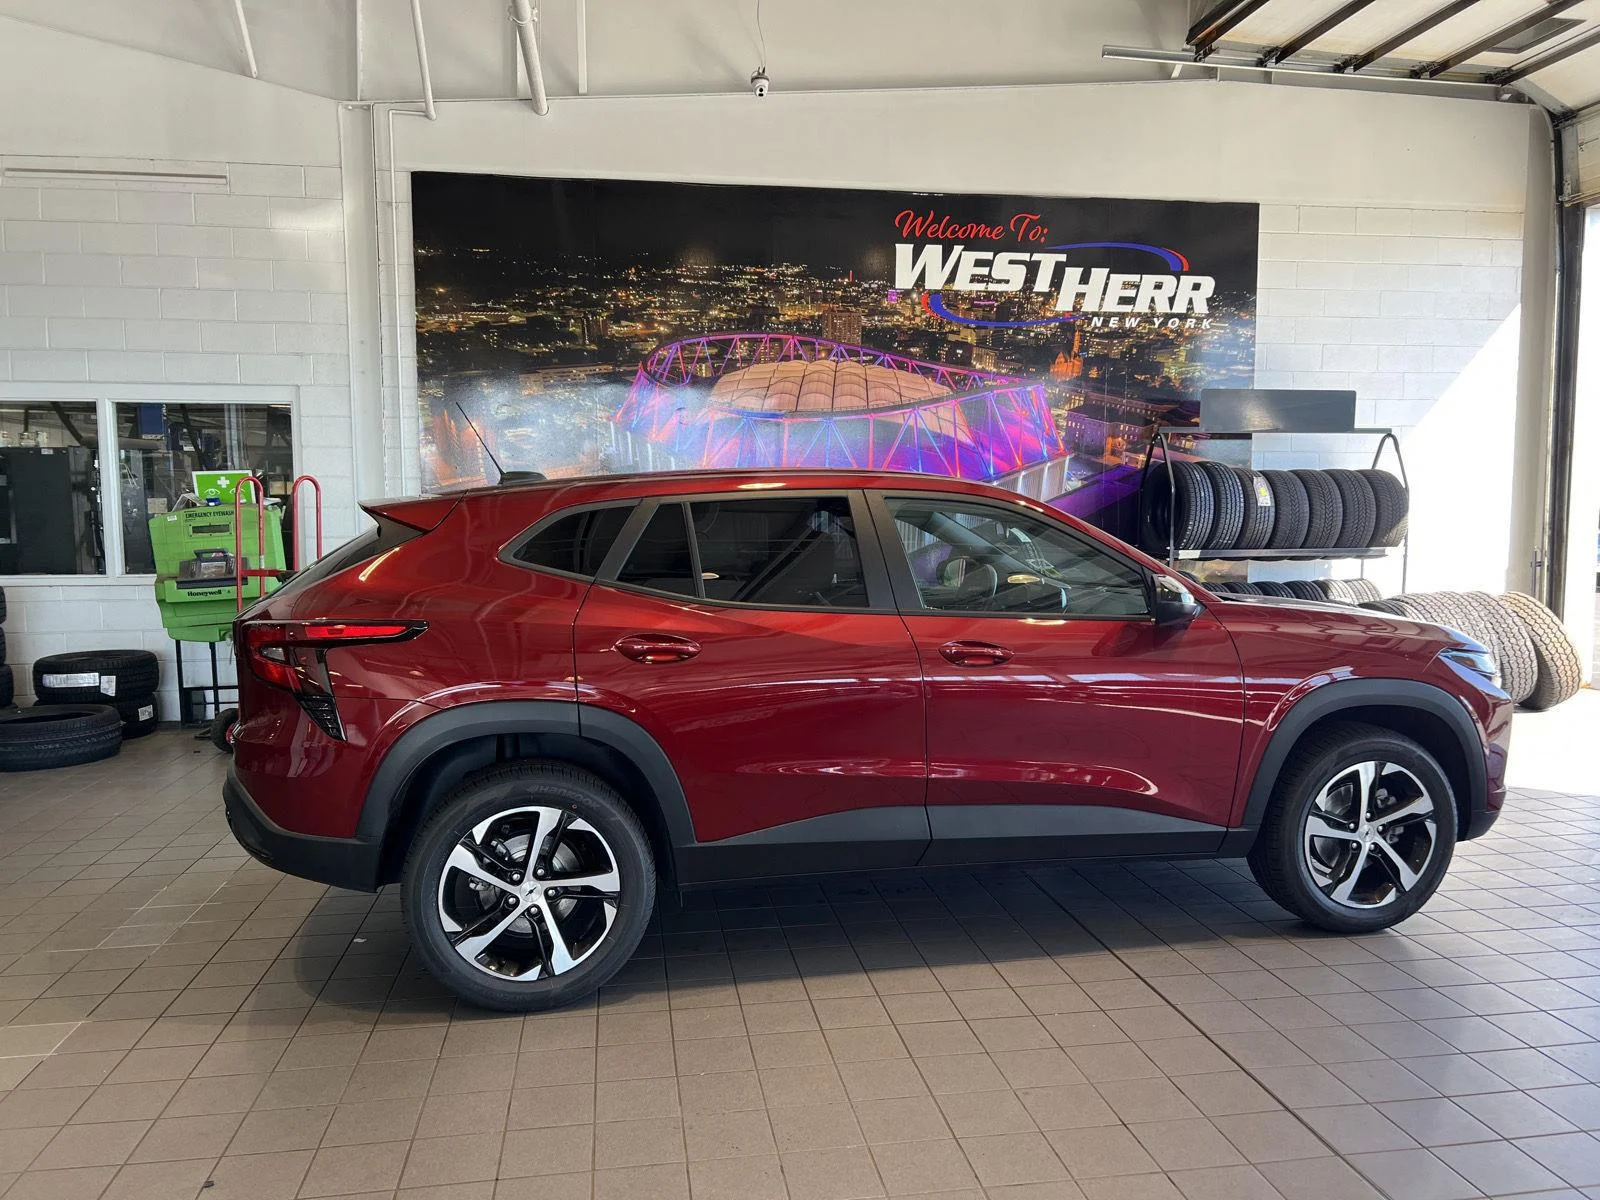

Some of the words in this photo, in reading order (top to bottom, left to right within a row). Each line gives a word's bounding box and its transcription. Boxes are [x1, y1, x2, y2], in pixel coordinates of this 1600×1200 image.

[895, 210, 1005, 240] Welcome
[1009, 213, 1048, 243] To:
[895, 243, 1067, 292] WEST
[1055, 267, 1215, 313] HERR
[1091, 316, 1139, 328] NEW
[1152, 317, 1212, 329] YORK
